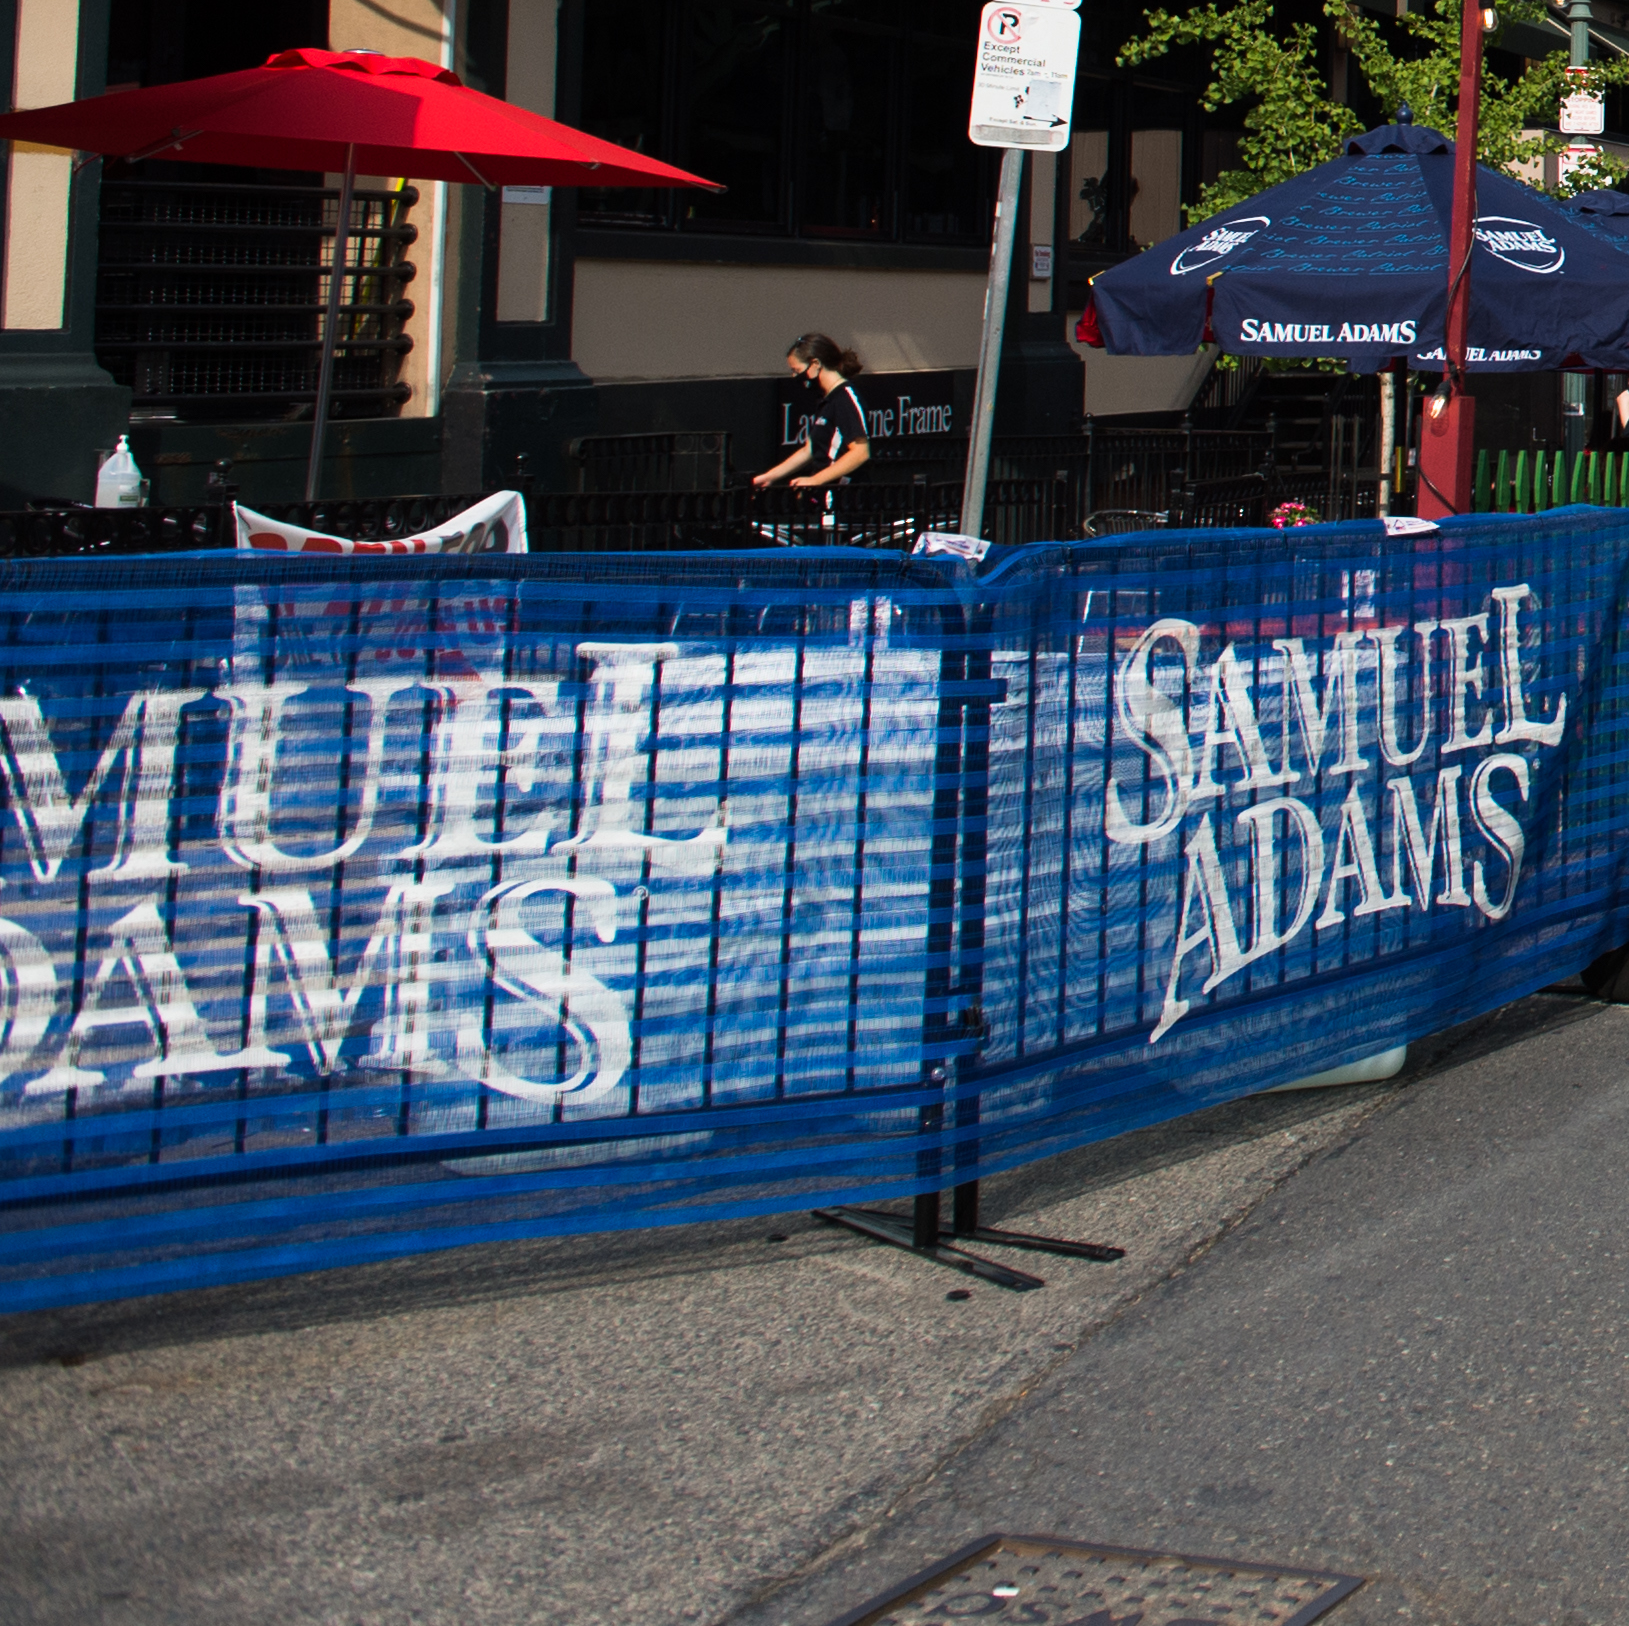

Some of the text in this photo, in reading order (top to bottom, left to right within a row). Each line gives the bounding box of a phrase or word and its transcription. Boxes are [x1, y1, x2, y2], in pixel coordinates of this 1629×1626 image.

[982, 52, 1046, 67] Commercial
[984, 41, 1020, 54] Except
[981, 63, 1025, 76] Vehicles
[1241, 319, 1417, 344] SAMUEL ADAMS
[896, 395, 953, 437] Frame
[1106, 583, 1567, 845] SAMUEL
[0, 641, 729, 885] MUEL
[1149, 753, 1531, 1045] ADAMS
